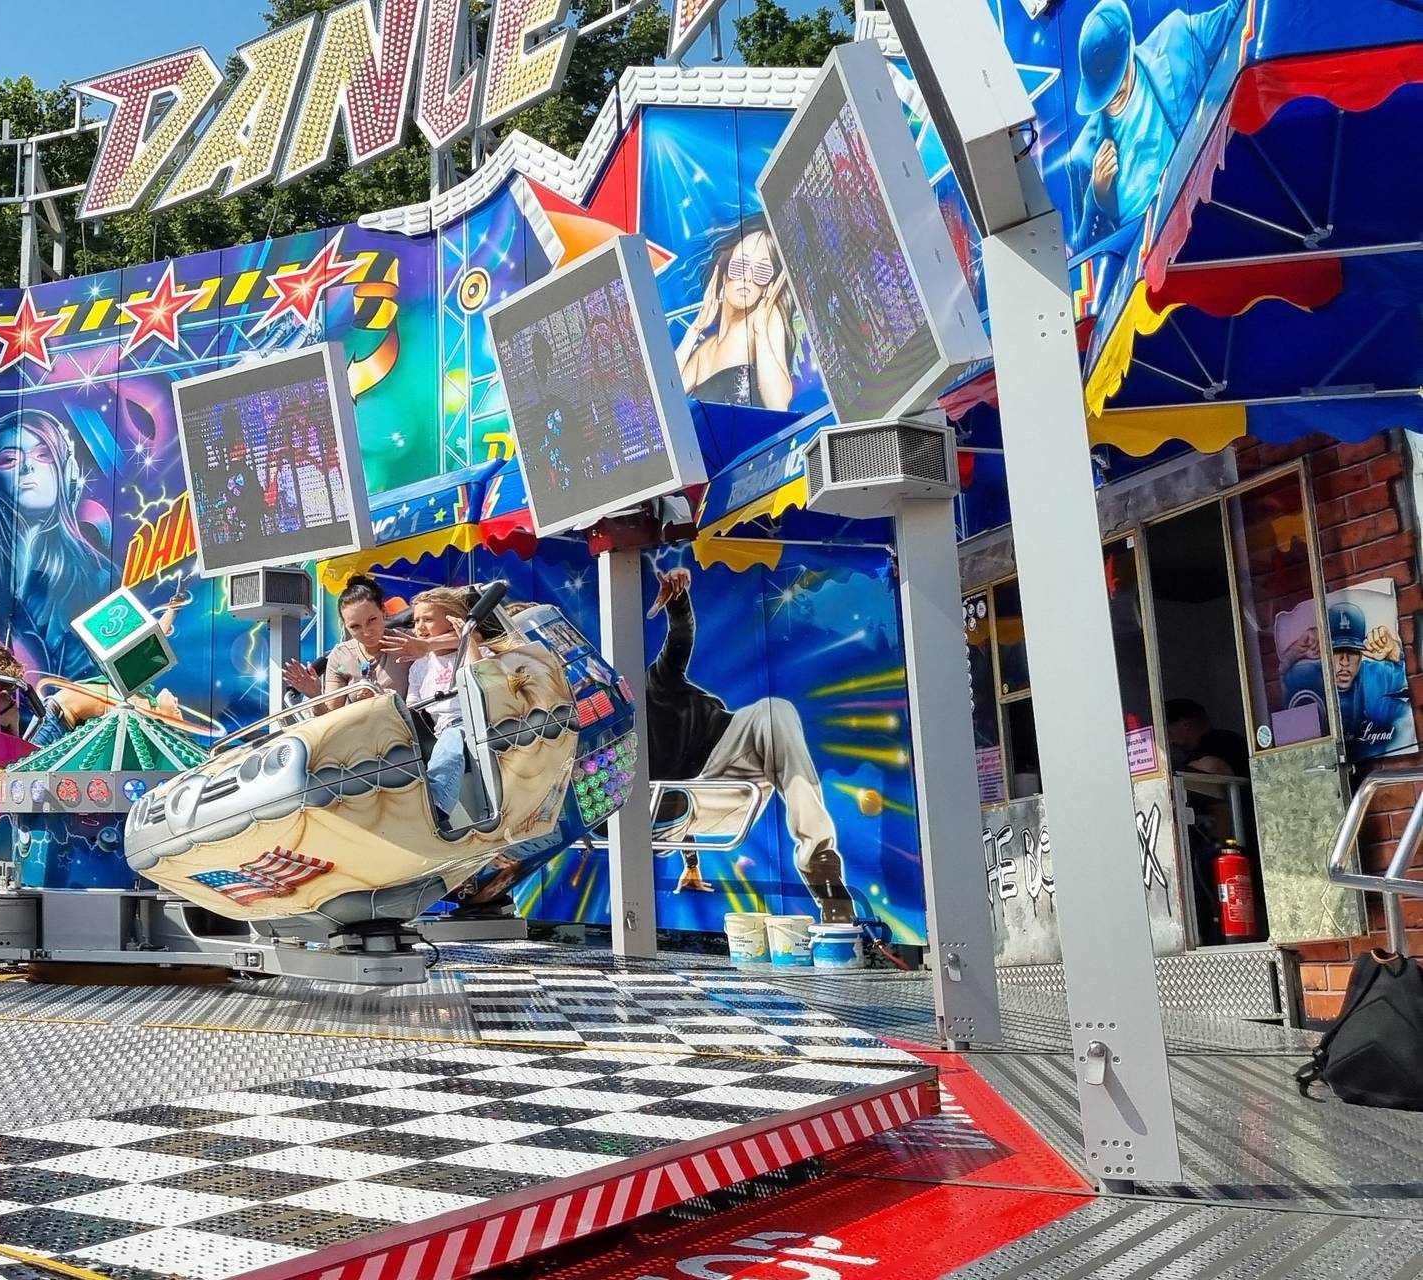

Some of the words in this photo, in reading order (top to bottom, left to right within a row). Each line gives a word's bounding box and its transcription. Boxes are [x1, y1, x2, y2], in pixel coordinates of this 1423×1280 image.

[70, 0, 577, 219] DANCE
[99, 604, 129, 637] 3
[1358, 720, 1395, 745] Legend
